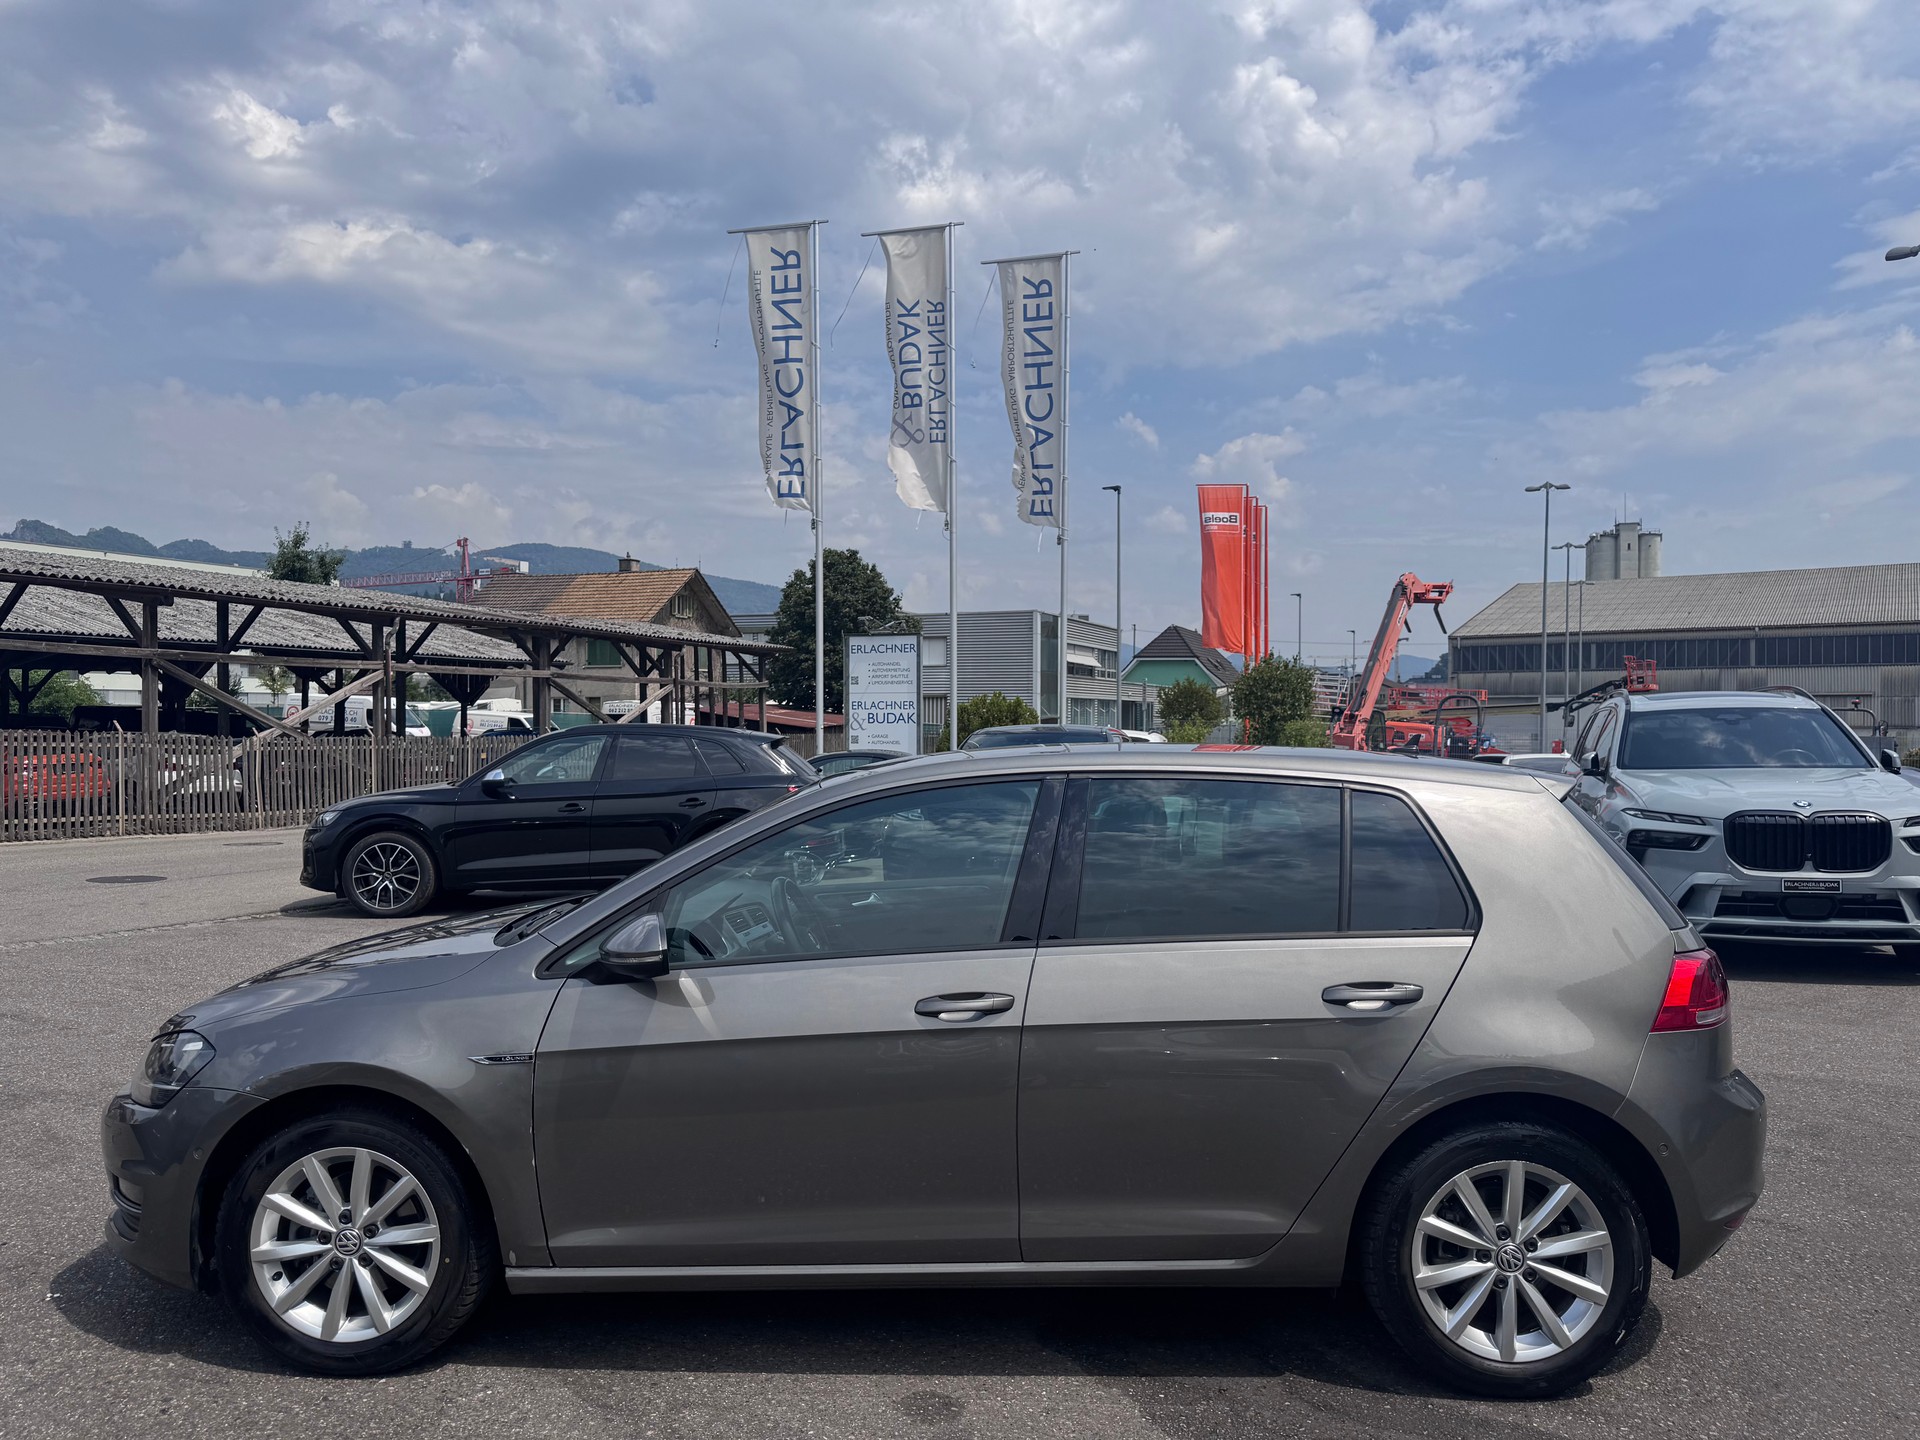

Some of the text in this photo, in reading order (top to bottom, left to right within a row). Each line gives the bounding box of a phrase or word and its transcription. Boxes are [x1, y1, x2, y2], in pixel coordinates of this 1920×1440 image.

[850, 643, 917, 654] ERLACHNER
[851, 701, 916, 710] ERLACHNER
[850, 712, 917, 731] & BUDAK
